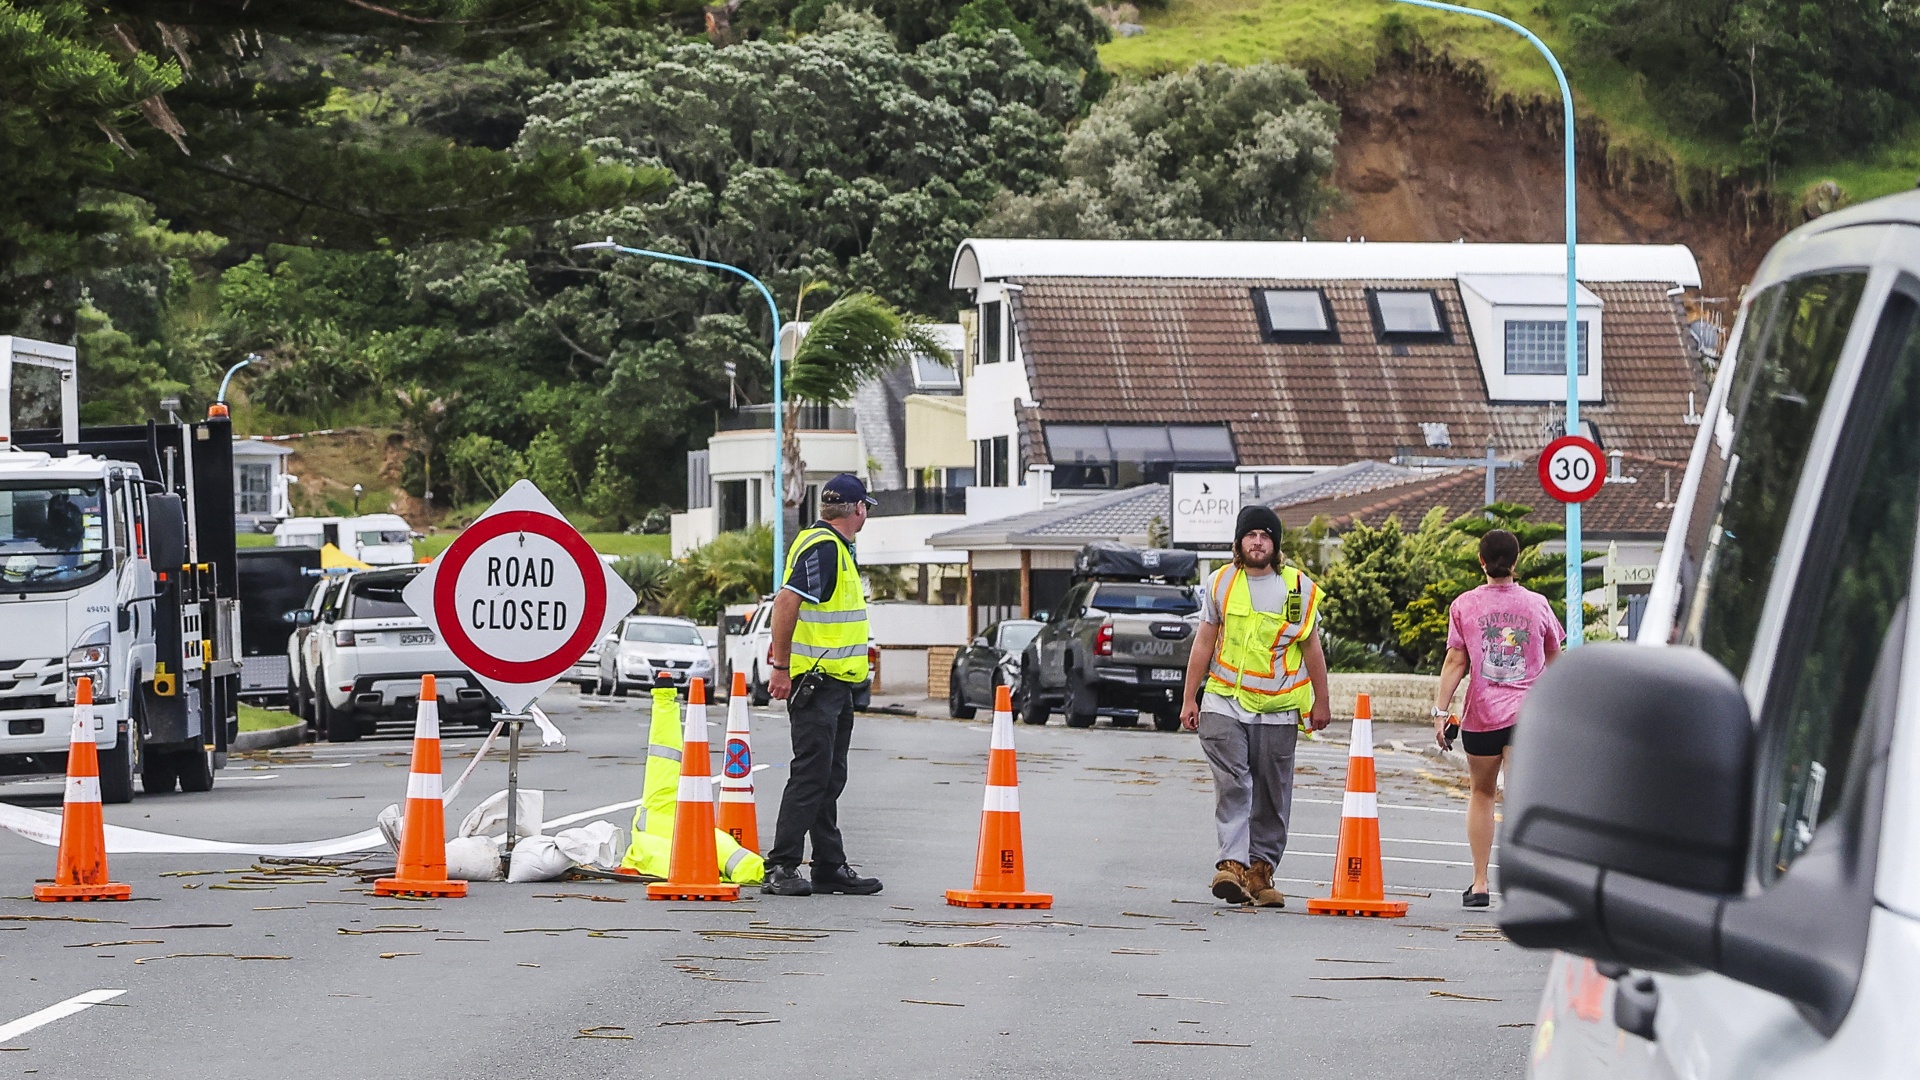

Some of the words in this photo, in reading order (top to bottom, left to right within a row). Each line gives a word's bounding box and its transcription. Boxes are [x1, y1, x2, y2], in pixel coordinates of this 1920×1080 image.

[1555, 457, 1589, 480] 30
[1178, 498, 1234, 515] CAPRI
[487, 556, 554, 587] ROAD
[472, 598, 567, 631] CLOSED
[1478, 612, 1501, 627] STAY
[1503, 612, 1532, 629] SALTY
